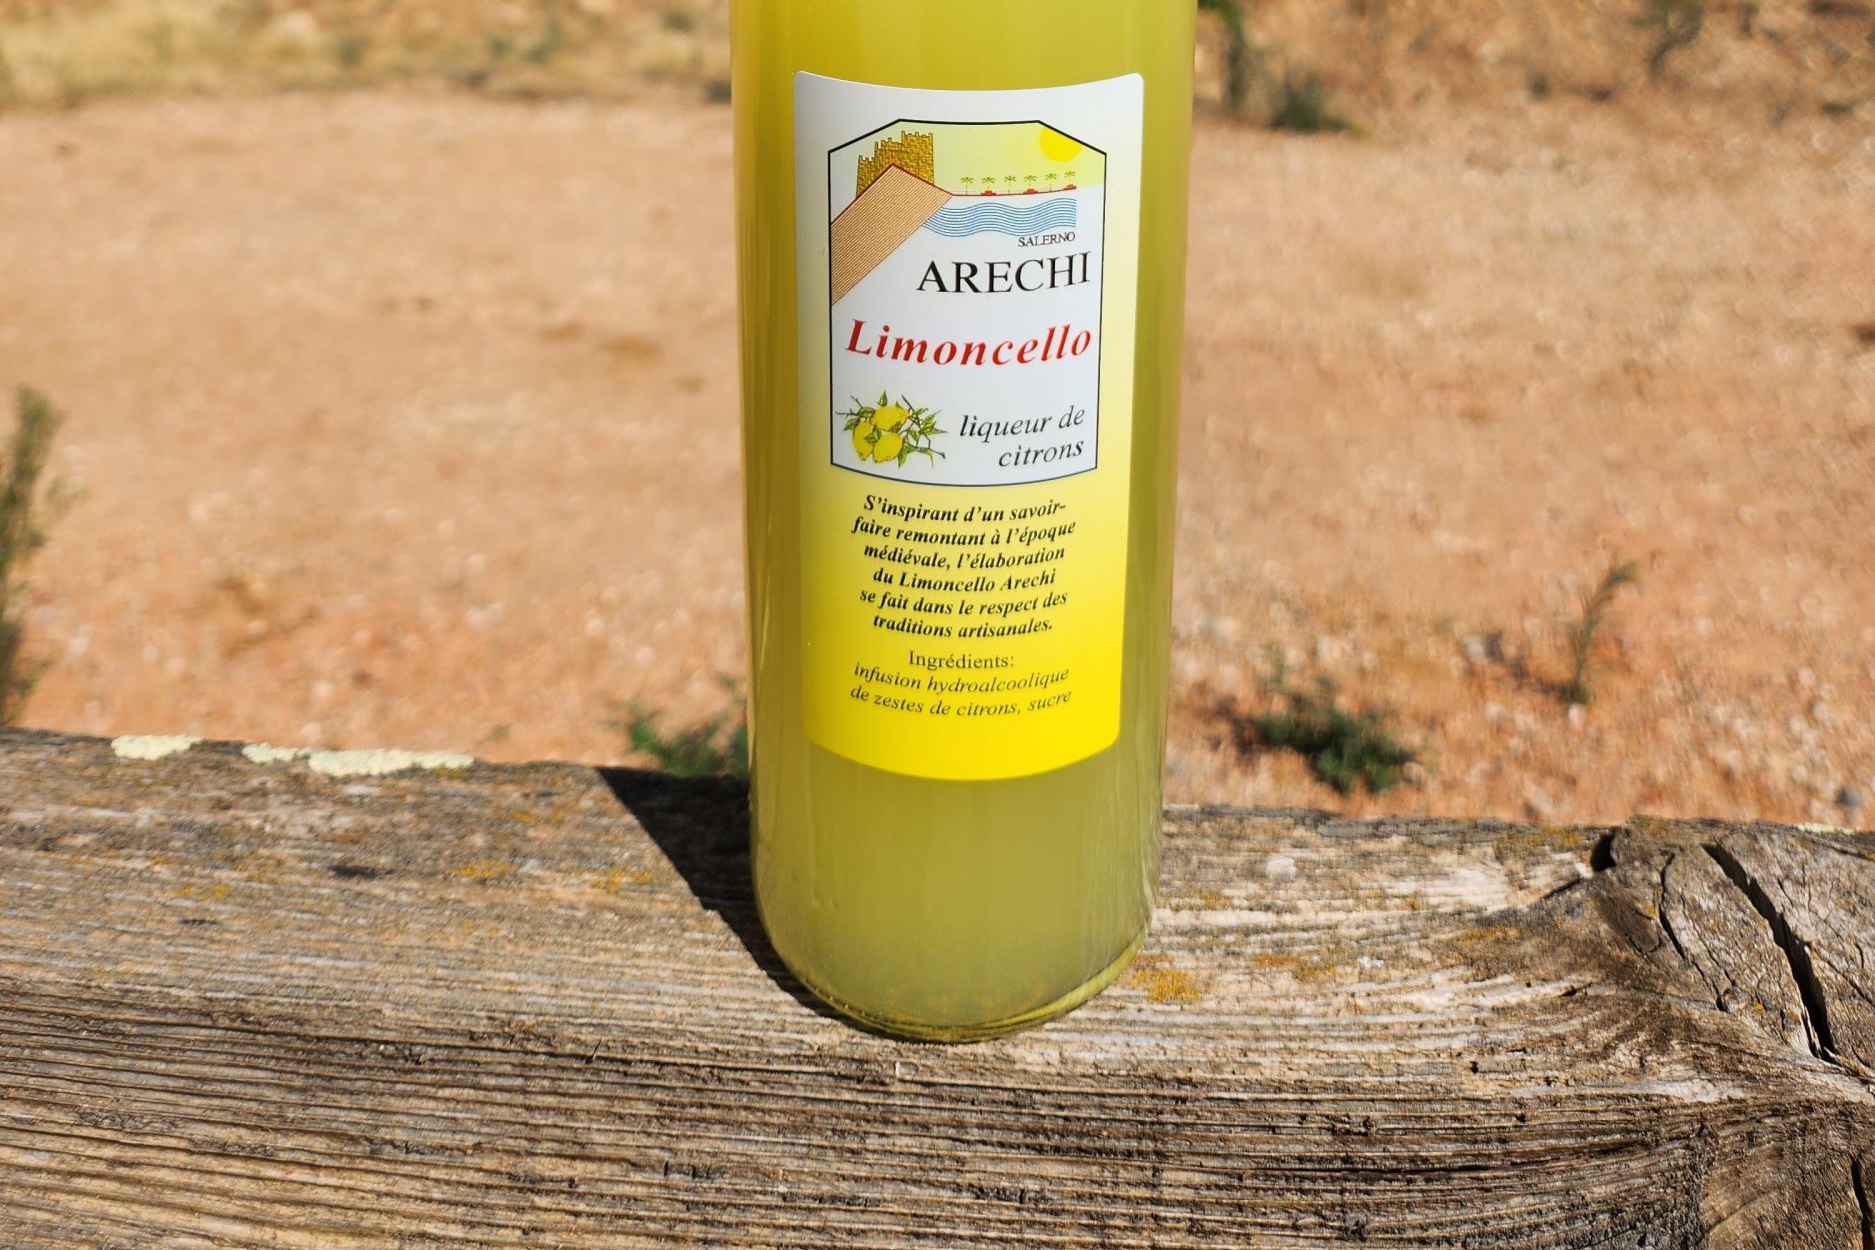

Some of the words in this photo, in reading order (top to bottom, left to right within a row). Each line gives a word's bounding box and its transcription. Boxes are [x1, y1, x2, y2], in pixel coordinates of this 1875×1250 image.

[1018, 231, 1075, 247] SALERNO
[917, 251, 1091, 293] ARECHI
[846, 318, 1091, 366] Limoncello
[960, 415, 1052, 444] liqueur
[1059, 405, 1085, 429] de
[999, 438, 1084, 467] citrons
[864, 494, 958, 523] S'inspirant
[964, 505, 1004, 522] d'un
[1010, 499, 1066, 520] savoir-
[851, 516, 891, 537] faire
[896, 526, 985, 546] remontant
[991, 529, 1001, 545] à
[1006, 520, 1075, 546] l'époque
[864, 545, 950, 570] médiévale,
[957, 547, 1065, 569] l'élaboration
[873, 569, 893, 585] du
[899, 574, 995, 592] Limoncello
[1000, 569, 1056, 591] Arechi
[860, 590, 875, 602] se
[878, 591, 909, 610] fait
[913, 598, 952, 615] dans
[959, 600, 973, 615] le
[979, 598, 1037, 618] respect
[1043, 590, 1067, 609] des
[873, 615, 952, 638] traditions
[958, 617, 1052, 638] artisanales.
[909, 650, 1014, 671] Ingrédients:
[854, 662, 921, 690] infusion
[927, 666, 1069, 696] hydroalcoolique
[851, 686, 869, 700] de
[874, 695, 923, 713] zestes
[930, 700, 951, 715] de
[957, 702, 1021, 717] citrons,
[1028, 689, 1071, 712] sucre
